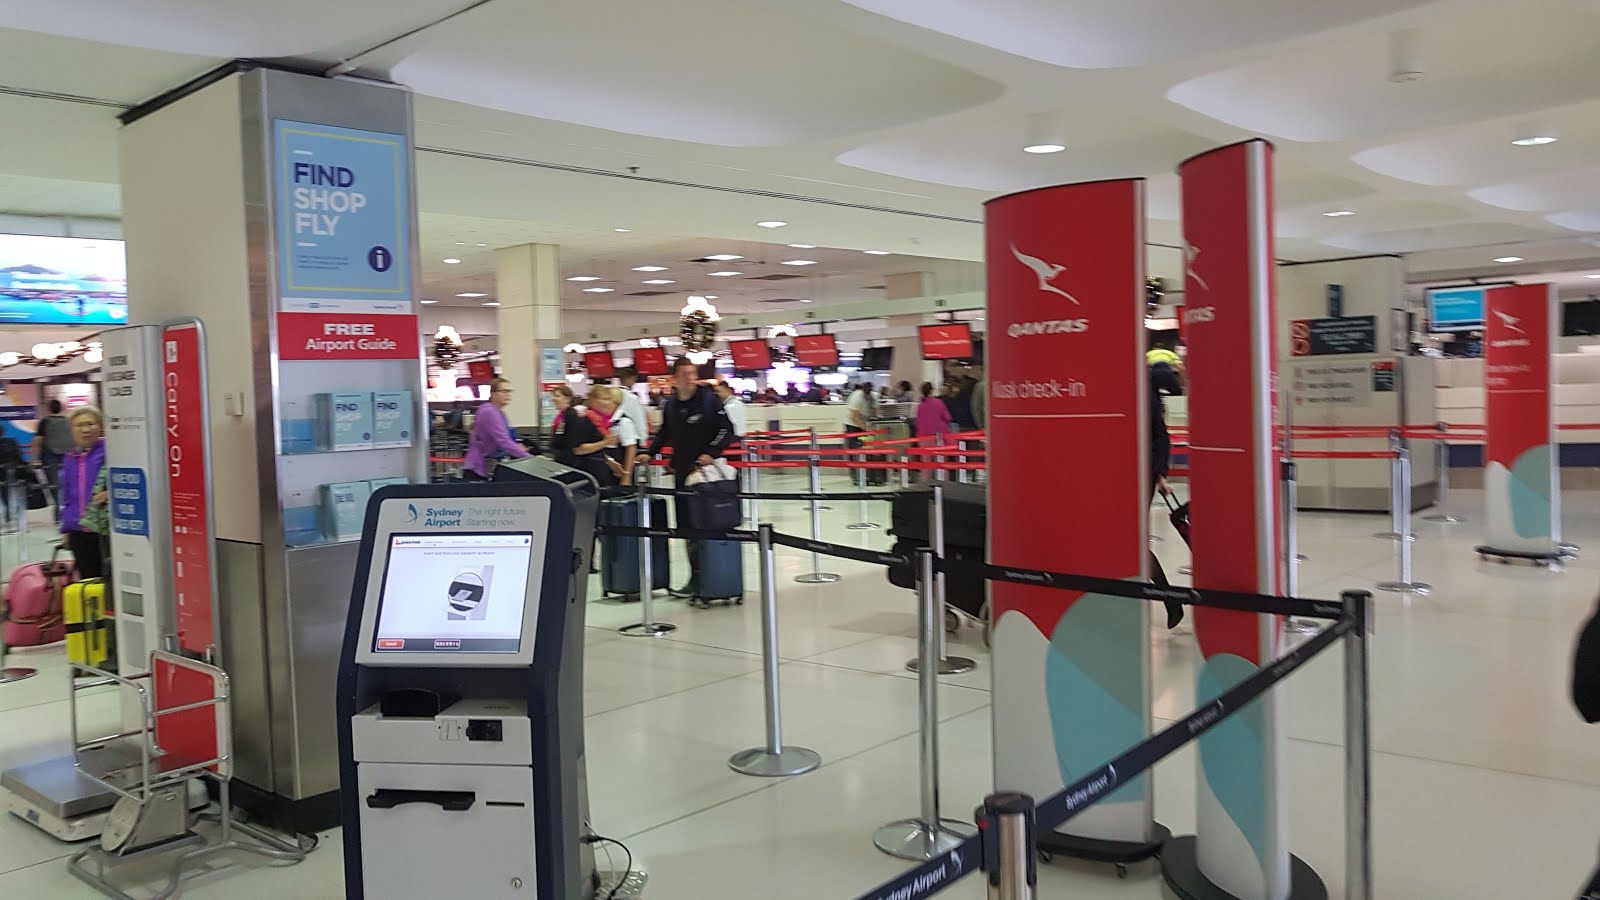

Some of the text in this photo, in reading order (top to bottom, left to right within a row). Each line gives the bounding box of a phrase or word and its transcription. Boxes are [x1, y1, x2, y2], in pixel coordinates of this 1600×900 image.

[294, 162, 354, 188] FIND
[295, 187, 367, 213] SHOP
[295, 212, 341, 236] FLY
[323, 323, 375, 335] FREE
[1007, 318, 1089, 338] QANTAS
[305, 338, 397, 353] Airport Guide
[1018, 378, 1086, 398] check-in
[335, 403, 358, 411] FIND
[376, 402, 398, 410] FIND
[426, 508, 463, 517] Sydney
[424, 518, 461, 528] Airport
[877, 862, 946, 900] dney Airport
